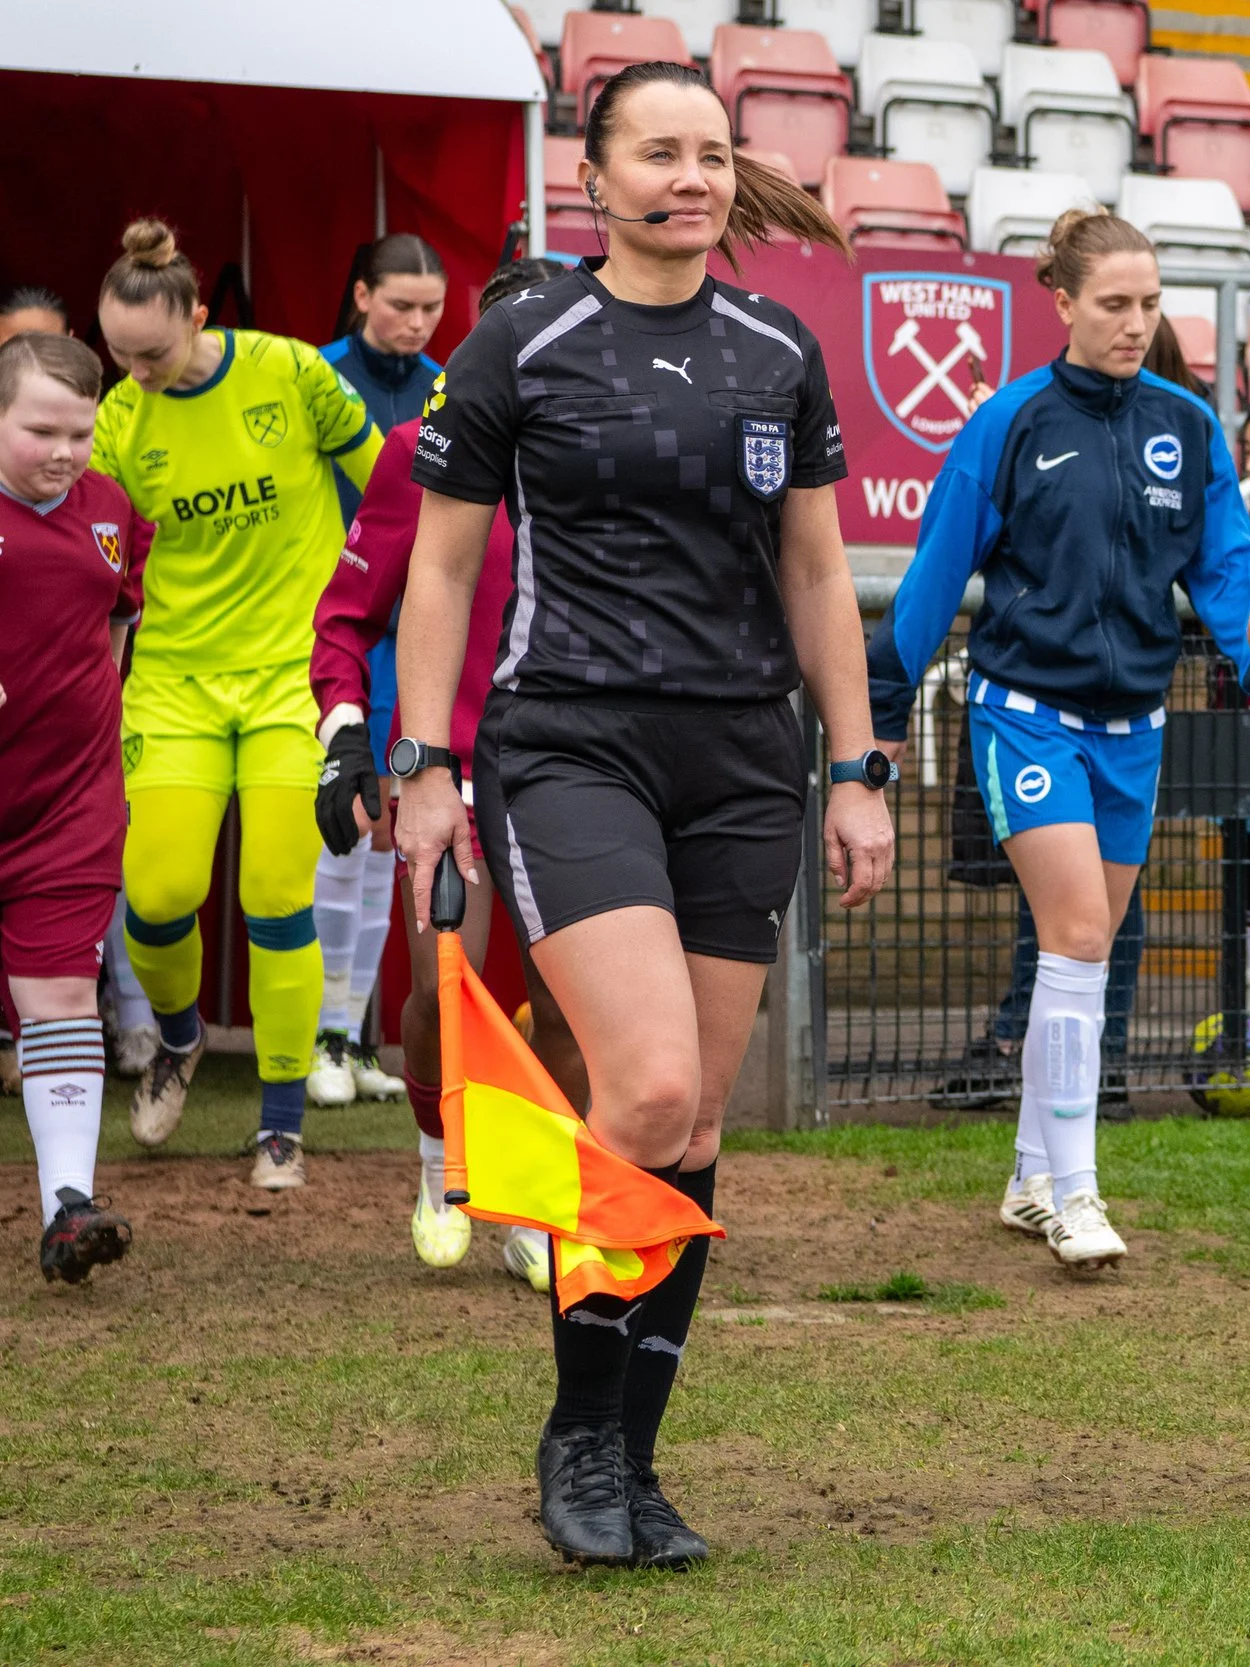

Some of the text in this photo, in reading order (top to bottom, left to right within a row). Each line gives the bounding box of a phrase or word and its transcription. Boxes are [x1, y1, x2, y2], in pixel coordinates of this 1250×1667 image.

[880, 281, 995, 310] WEST HAM
[903, 299, 971, 320] UNITED
[768, 424, 779, 433] FA
[416, 445, 448, 468] Supplies
[172, 475, 277, 522] BOYLE
[862, 476, 935, 520] WO
[213, 504, 279, 536] SPORTS
